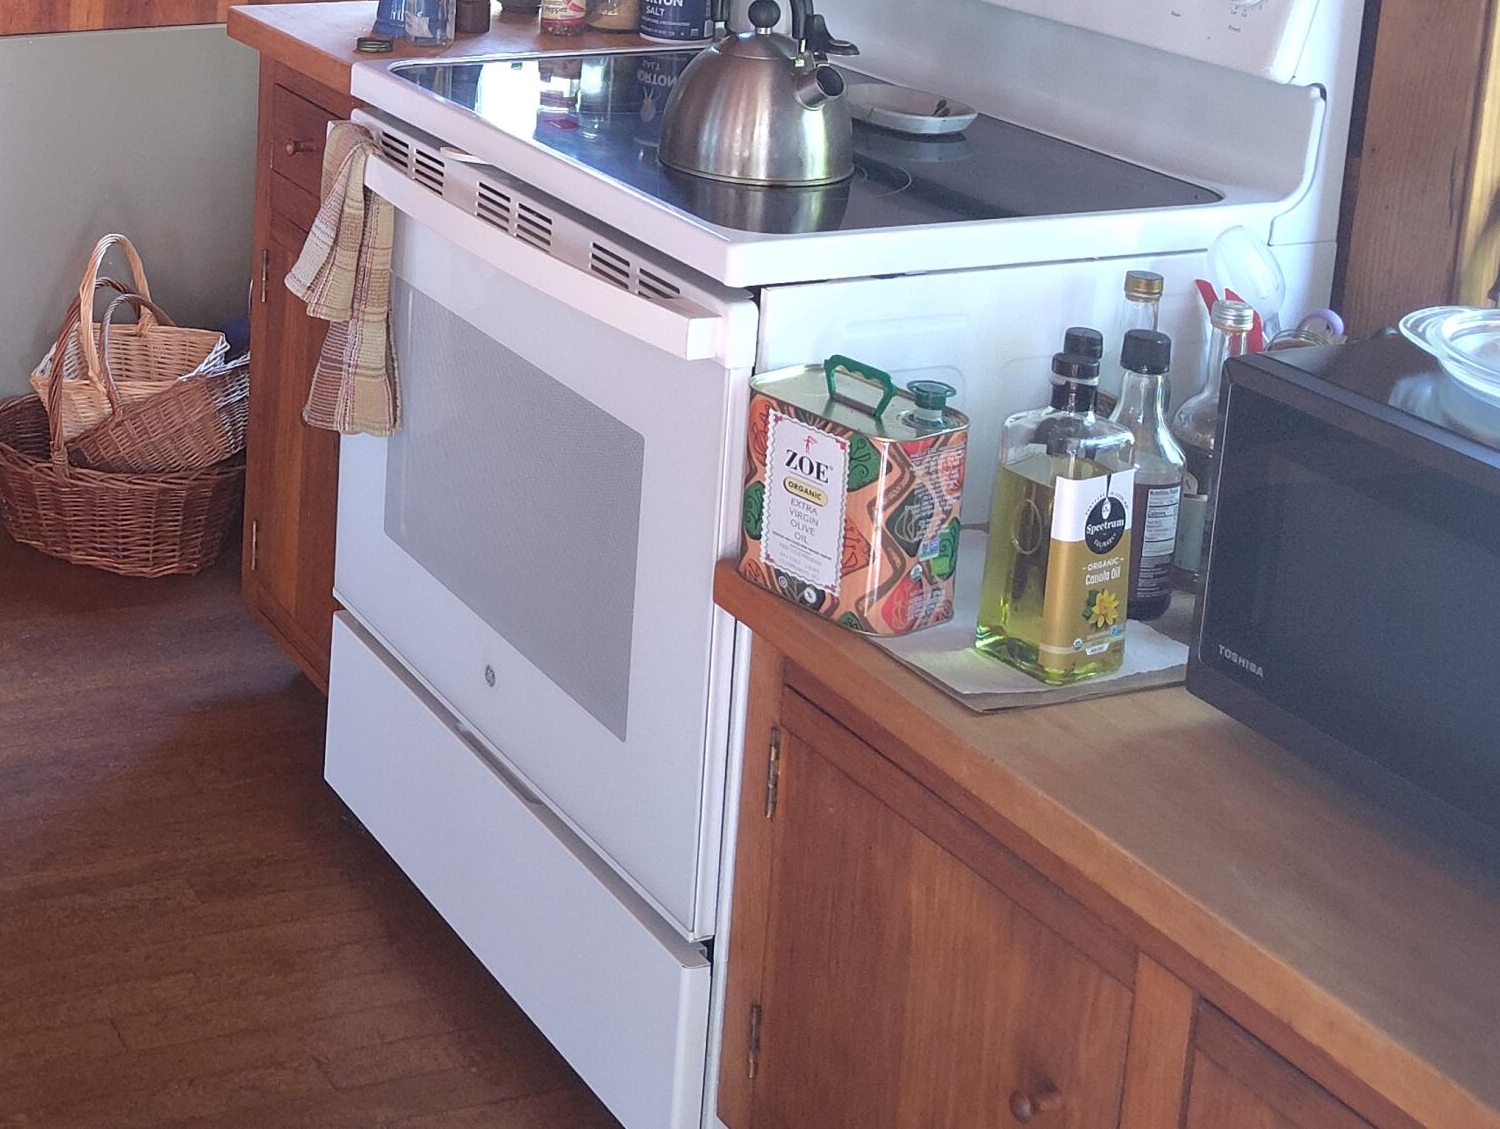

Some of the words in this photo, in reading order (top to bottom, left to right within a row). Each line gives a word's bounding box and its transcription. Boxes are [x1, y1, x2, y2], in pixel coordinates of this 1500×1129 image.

[645, 5, 665, 17] SALT
[785, 449, 829, 484] ZOE
[787, 480, 823, 502] ORGANIC
[790, 498, 819, 516] EXTRA
[789, 507, 819, 527] VIRGIN
[790, 518, 816, 538] OLIVE
[1086, 518, 1126, 536] Spectrum
[794, 531, 809, 545] OIL
[1087, 556, 1120, 572] ORGANIC
[1085, 570, 1110, 586] Canola
[1218, 643, 1264, 679] TOSHIBA
